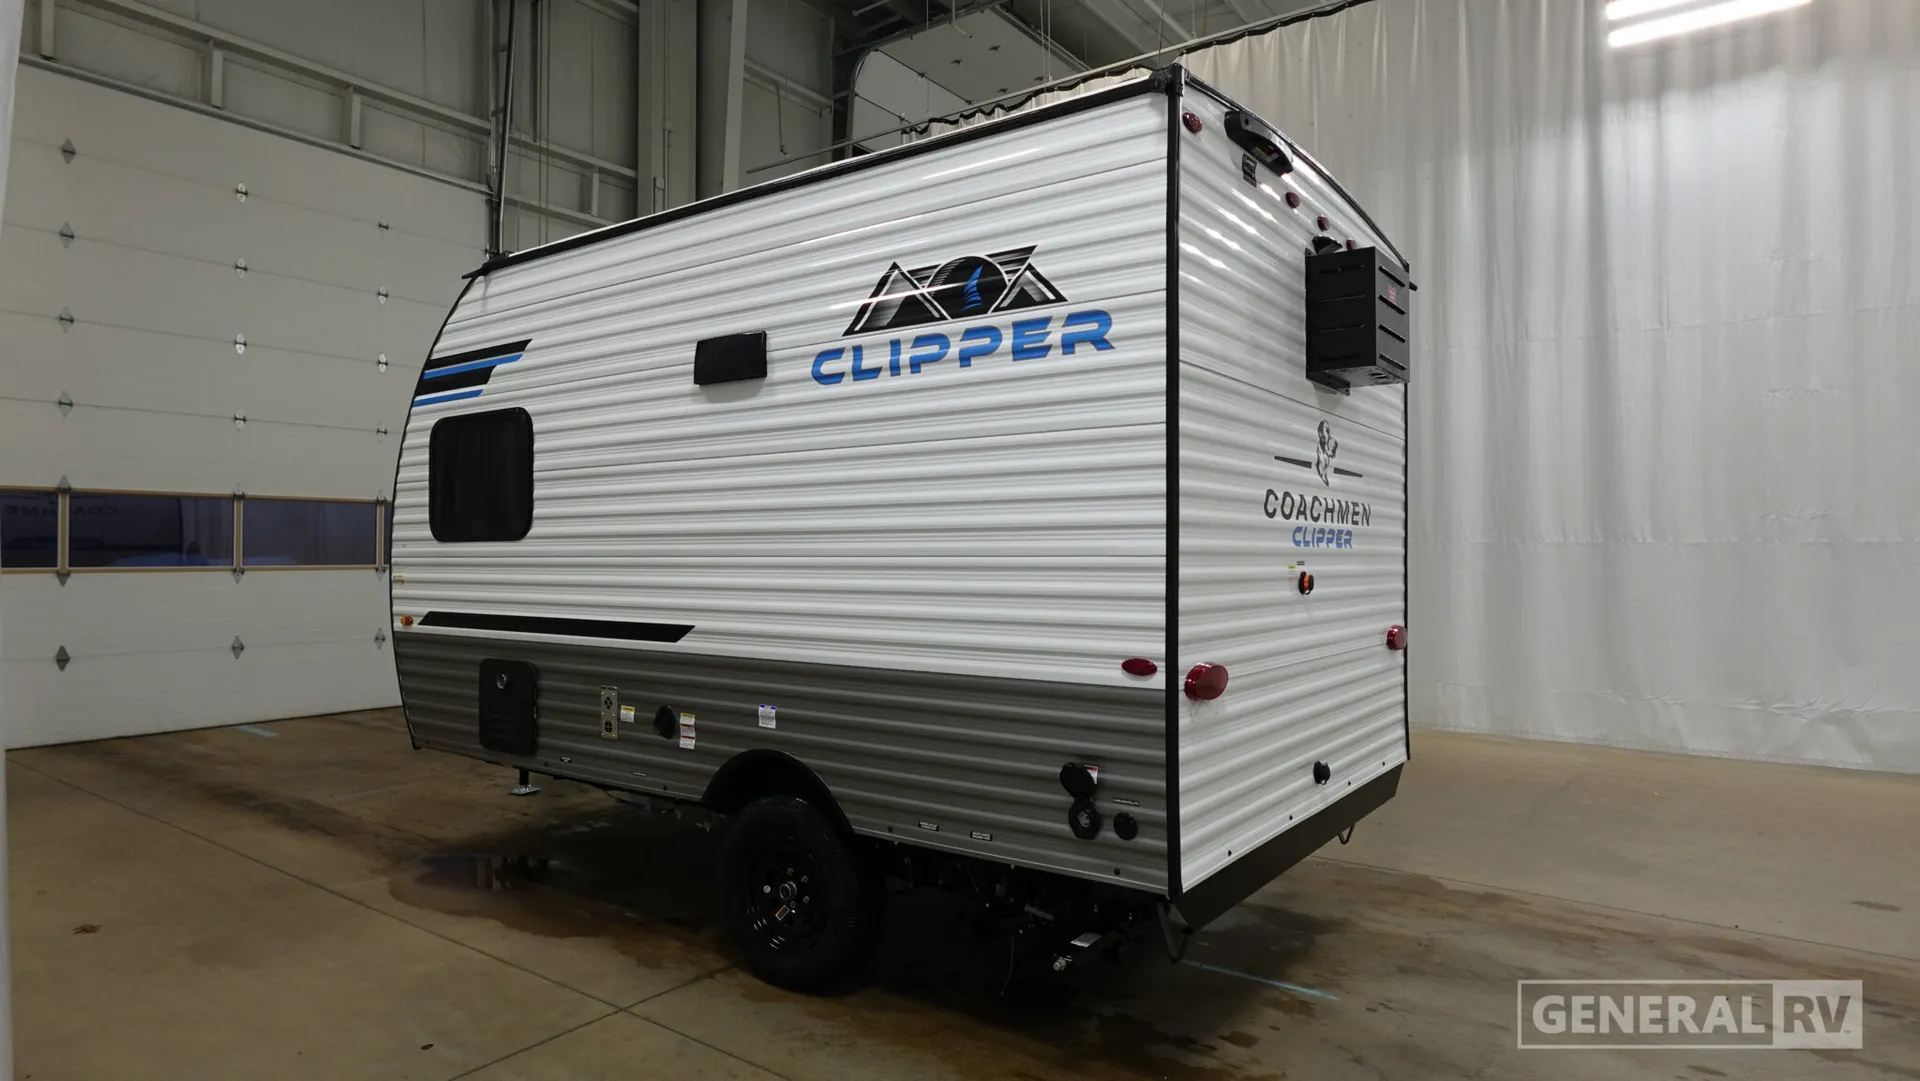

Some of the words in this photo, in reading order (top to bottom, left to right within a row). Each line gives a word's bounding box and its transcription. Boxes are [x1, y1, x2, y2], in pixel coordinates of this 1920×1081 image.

[811, 309, 1116, 385] CLIPPER
[1263, 488, 1372, 527] COACHMEN
[1292, 526, 1353, 549] CLIPPER
